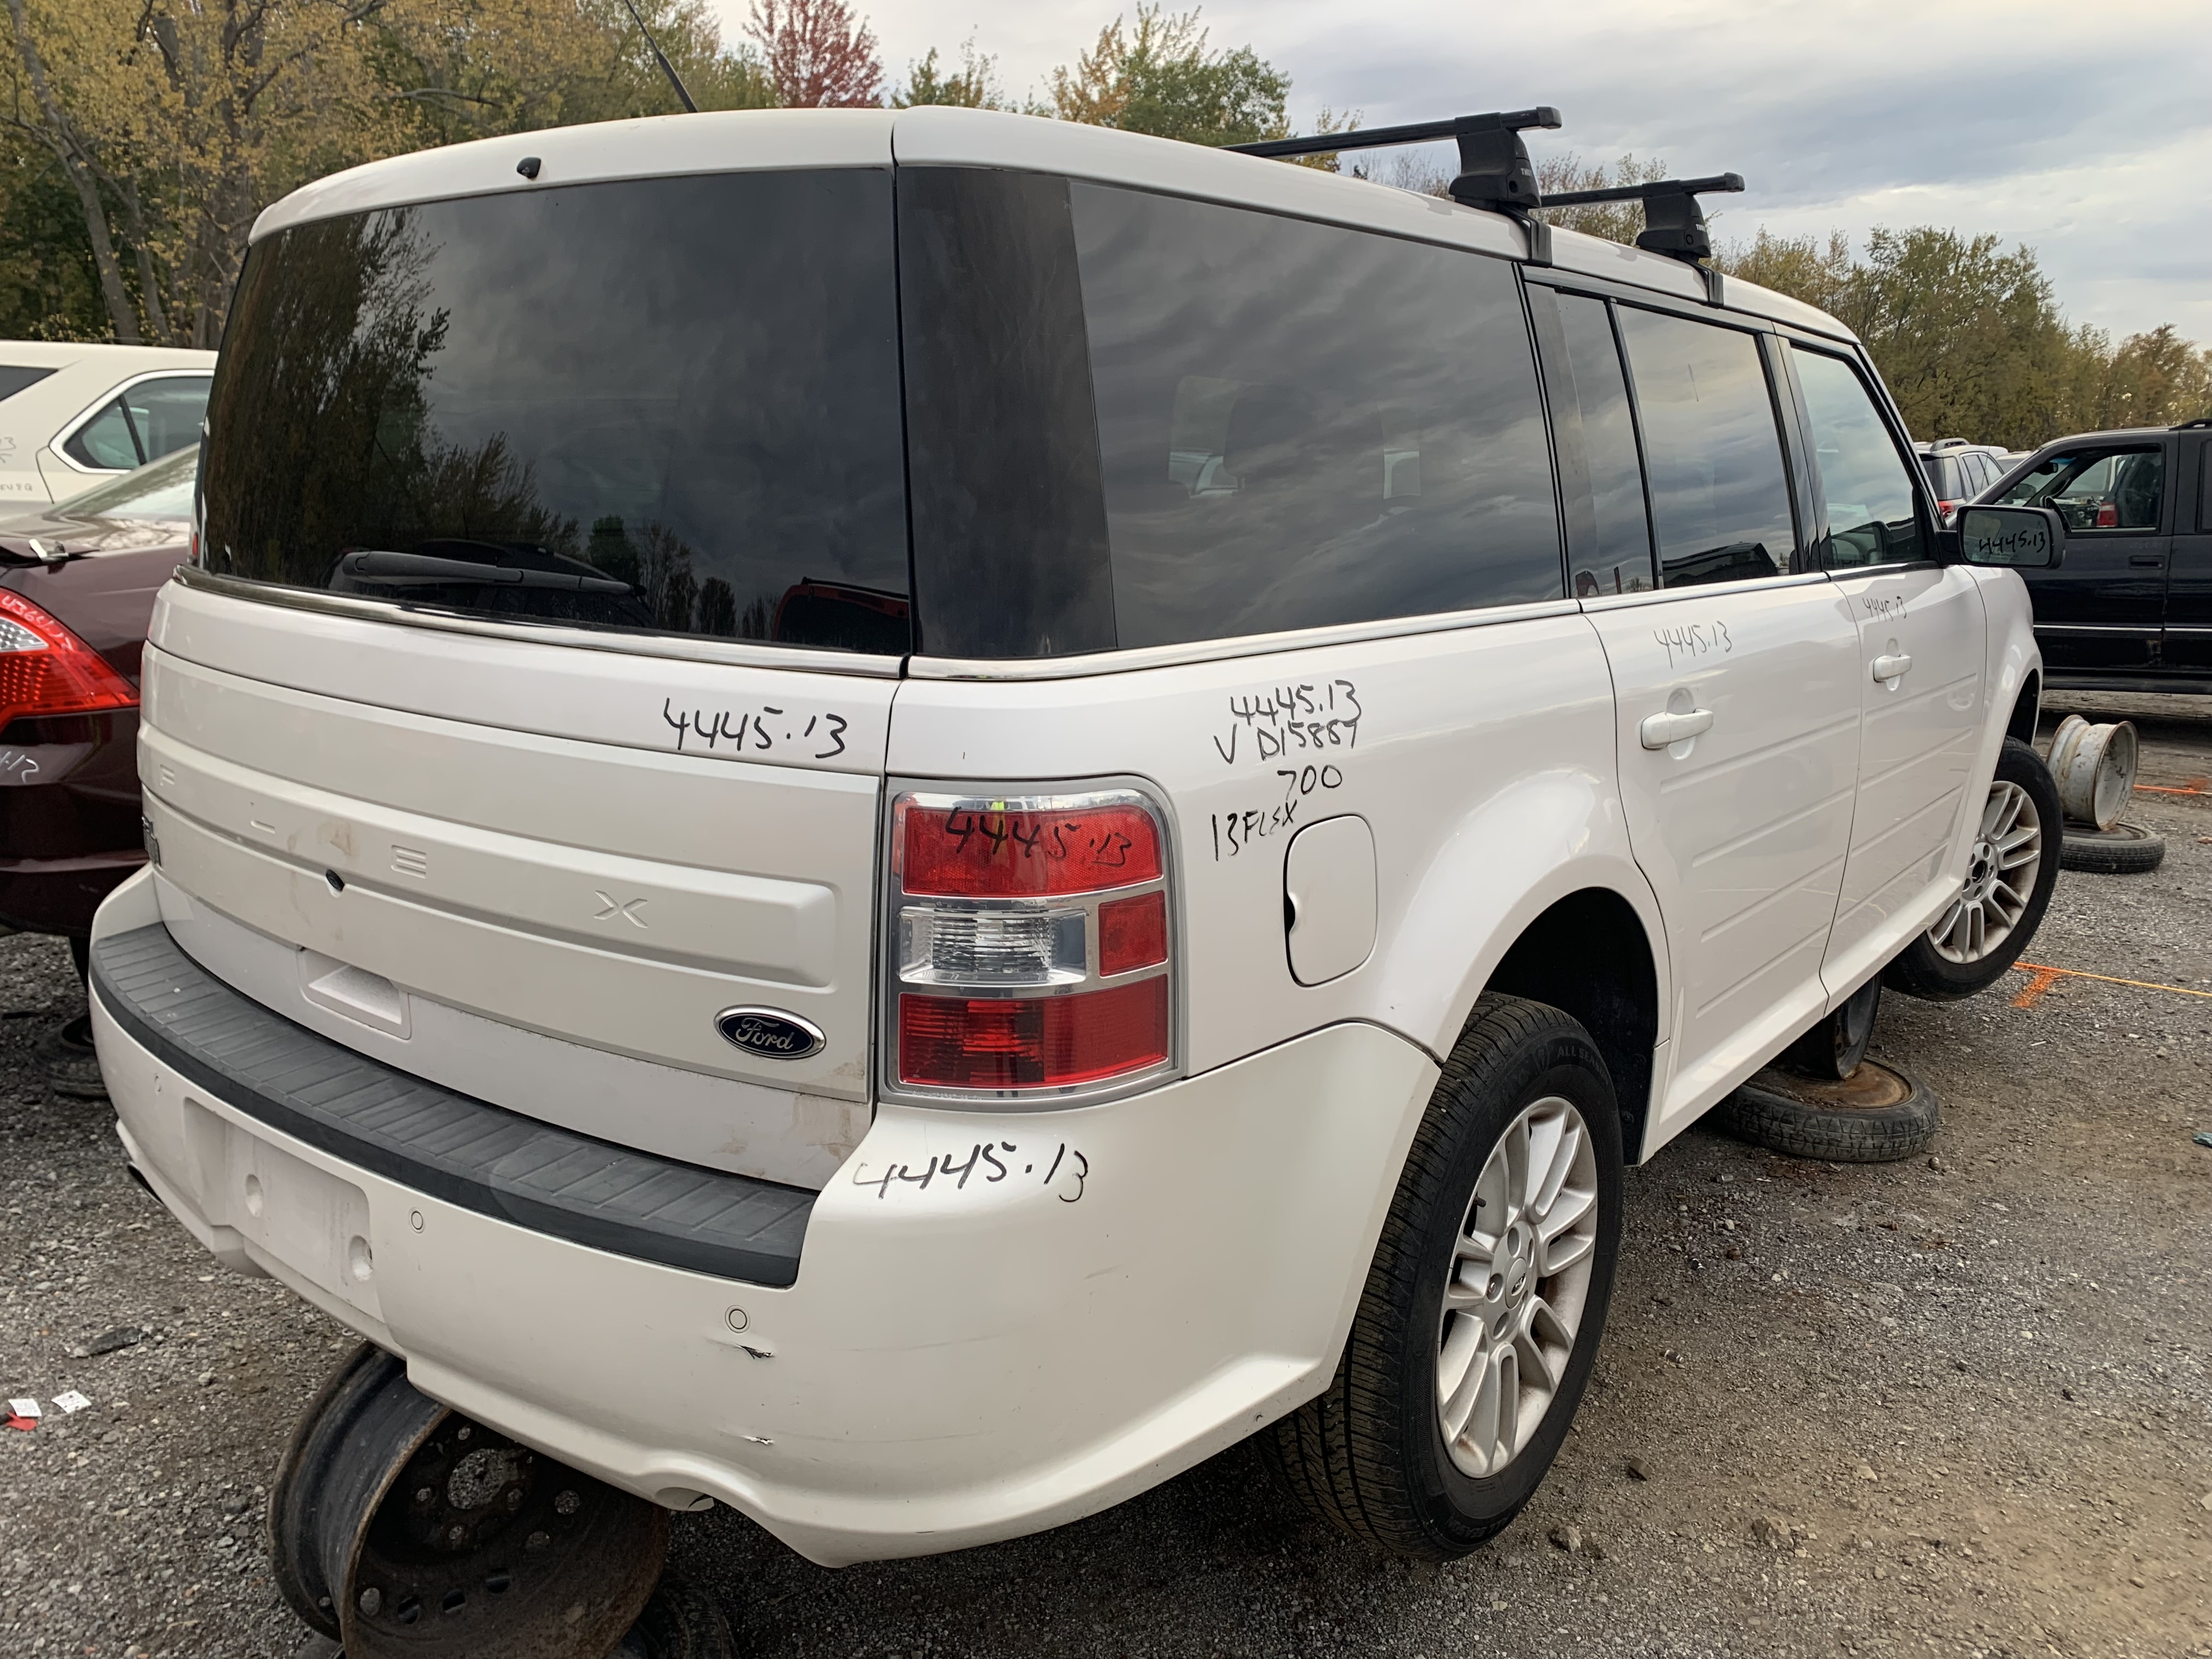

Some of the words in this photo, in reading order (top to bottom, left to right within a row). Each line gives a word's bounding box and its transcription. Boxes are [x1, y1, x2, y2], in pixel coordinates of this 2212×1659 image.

[1979, 530, 2046, 554] 4445.13
[1653, 620, 1732, 669] 4445.13
[1231, 680, 1362, 727] 4445.13
[663, 697, 847, 758] 4445.13
[1277, 765, 1342, 802] 700
[945, 806, 1132, 867] 4445.13
[735, 1017, 795, 1050] Ford
[1557, 1045, 1577, 1059] ALL
[853, 1141, 1088, 1203] 4445.13
